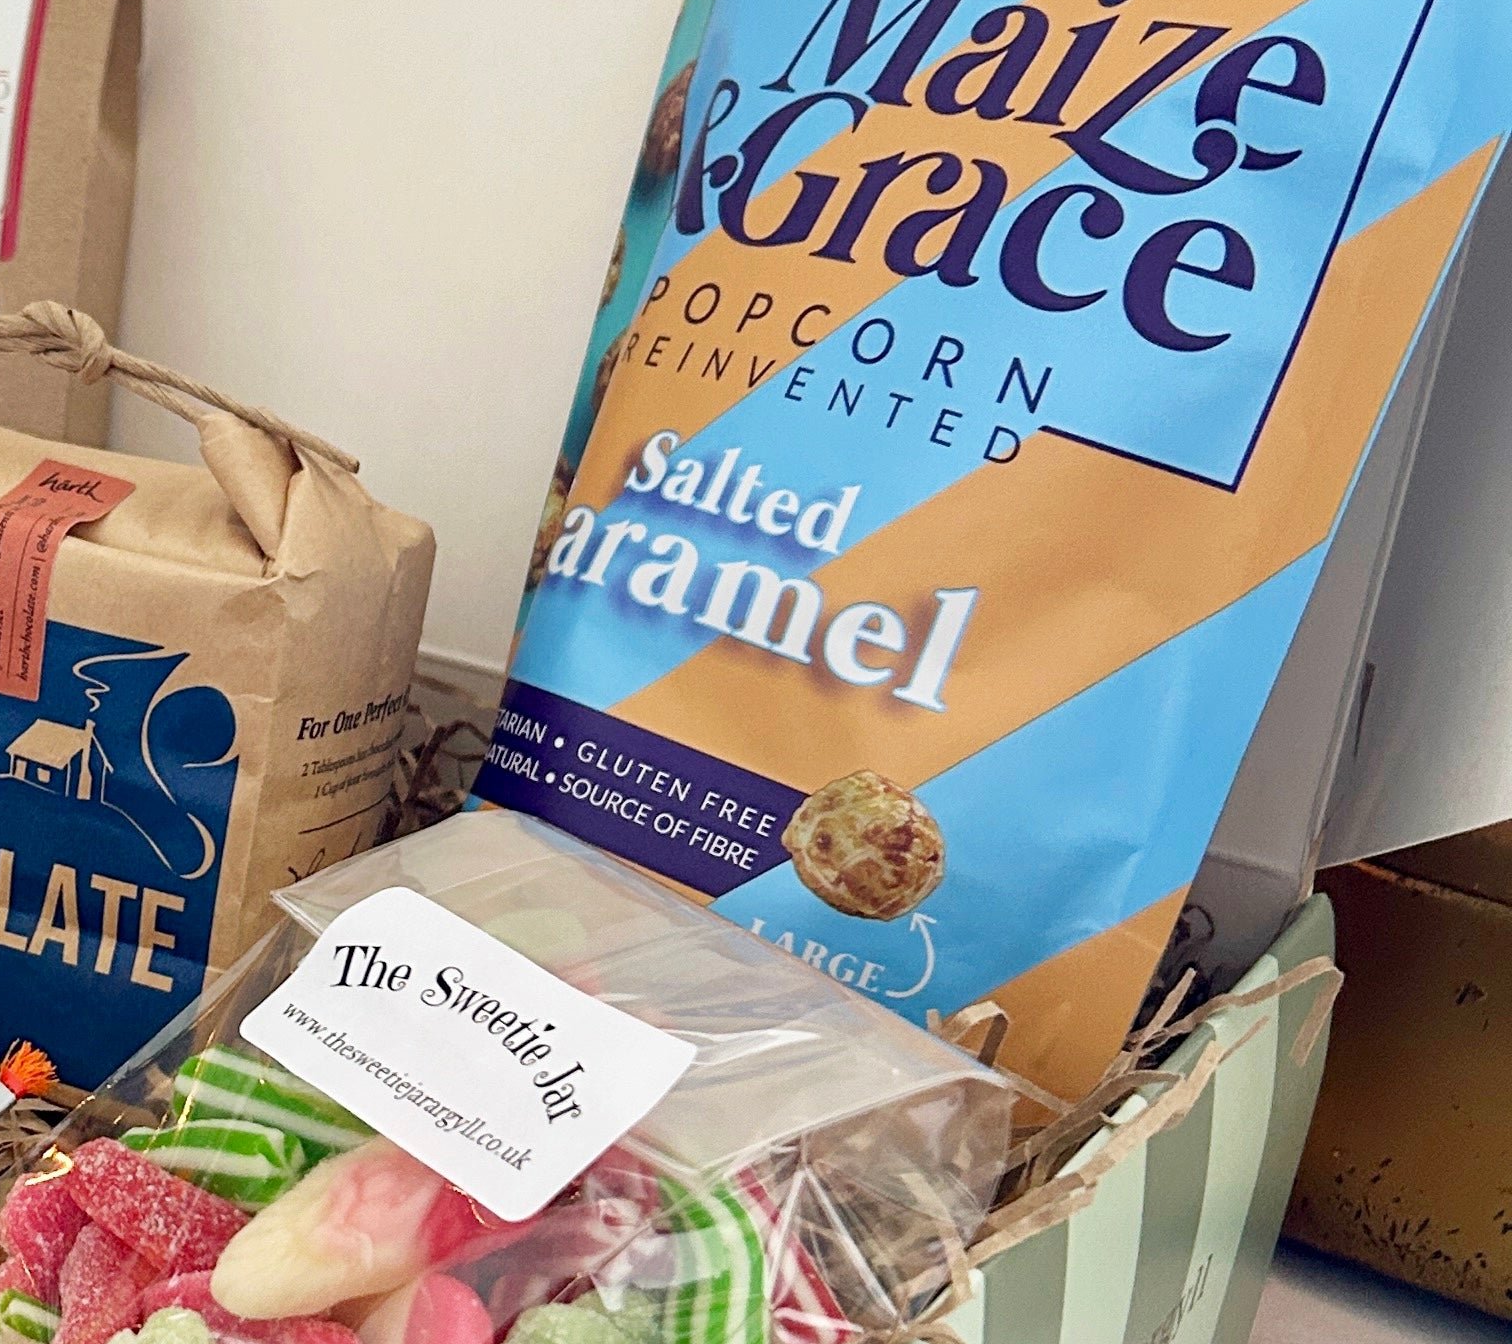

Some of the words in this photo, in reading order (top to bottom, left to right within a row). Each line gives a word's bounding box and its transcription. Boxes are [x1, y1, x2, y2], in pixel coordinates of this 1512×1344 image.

[718, 90, 1256, 354] Grace
[621, 332, 1023, 466] REINVENTED
[641, 275, 1055, 415] POPCORN
[623, 428, 862, 556] Salted
[547, 504, 980, 713] aramel
[296, 716, 331, 741] For
[332, 710, 362, 735] One
[497, 708, 548, 744] TARIAN
[577, 740, 691, 802] GLUTEN
[700, 791, 777, 838] FREE
[484, 743, 540, 782] ATURAL
[558, 773, 653, 826] SOURCE
[653, 812, 690, 840] OF
[689, 827, 760, 871] FIBRE
[282, 1002, 535, 1173] www.thesweetiejarargyll.co.uk
[330, 944, 412, 994] The
[420, 965, 556, 1068] Sweetie
[532, 1061, 586, 1126] Jar
